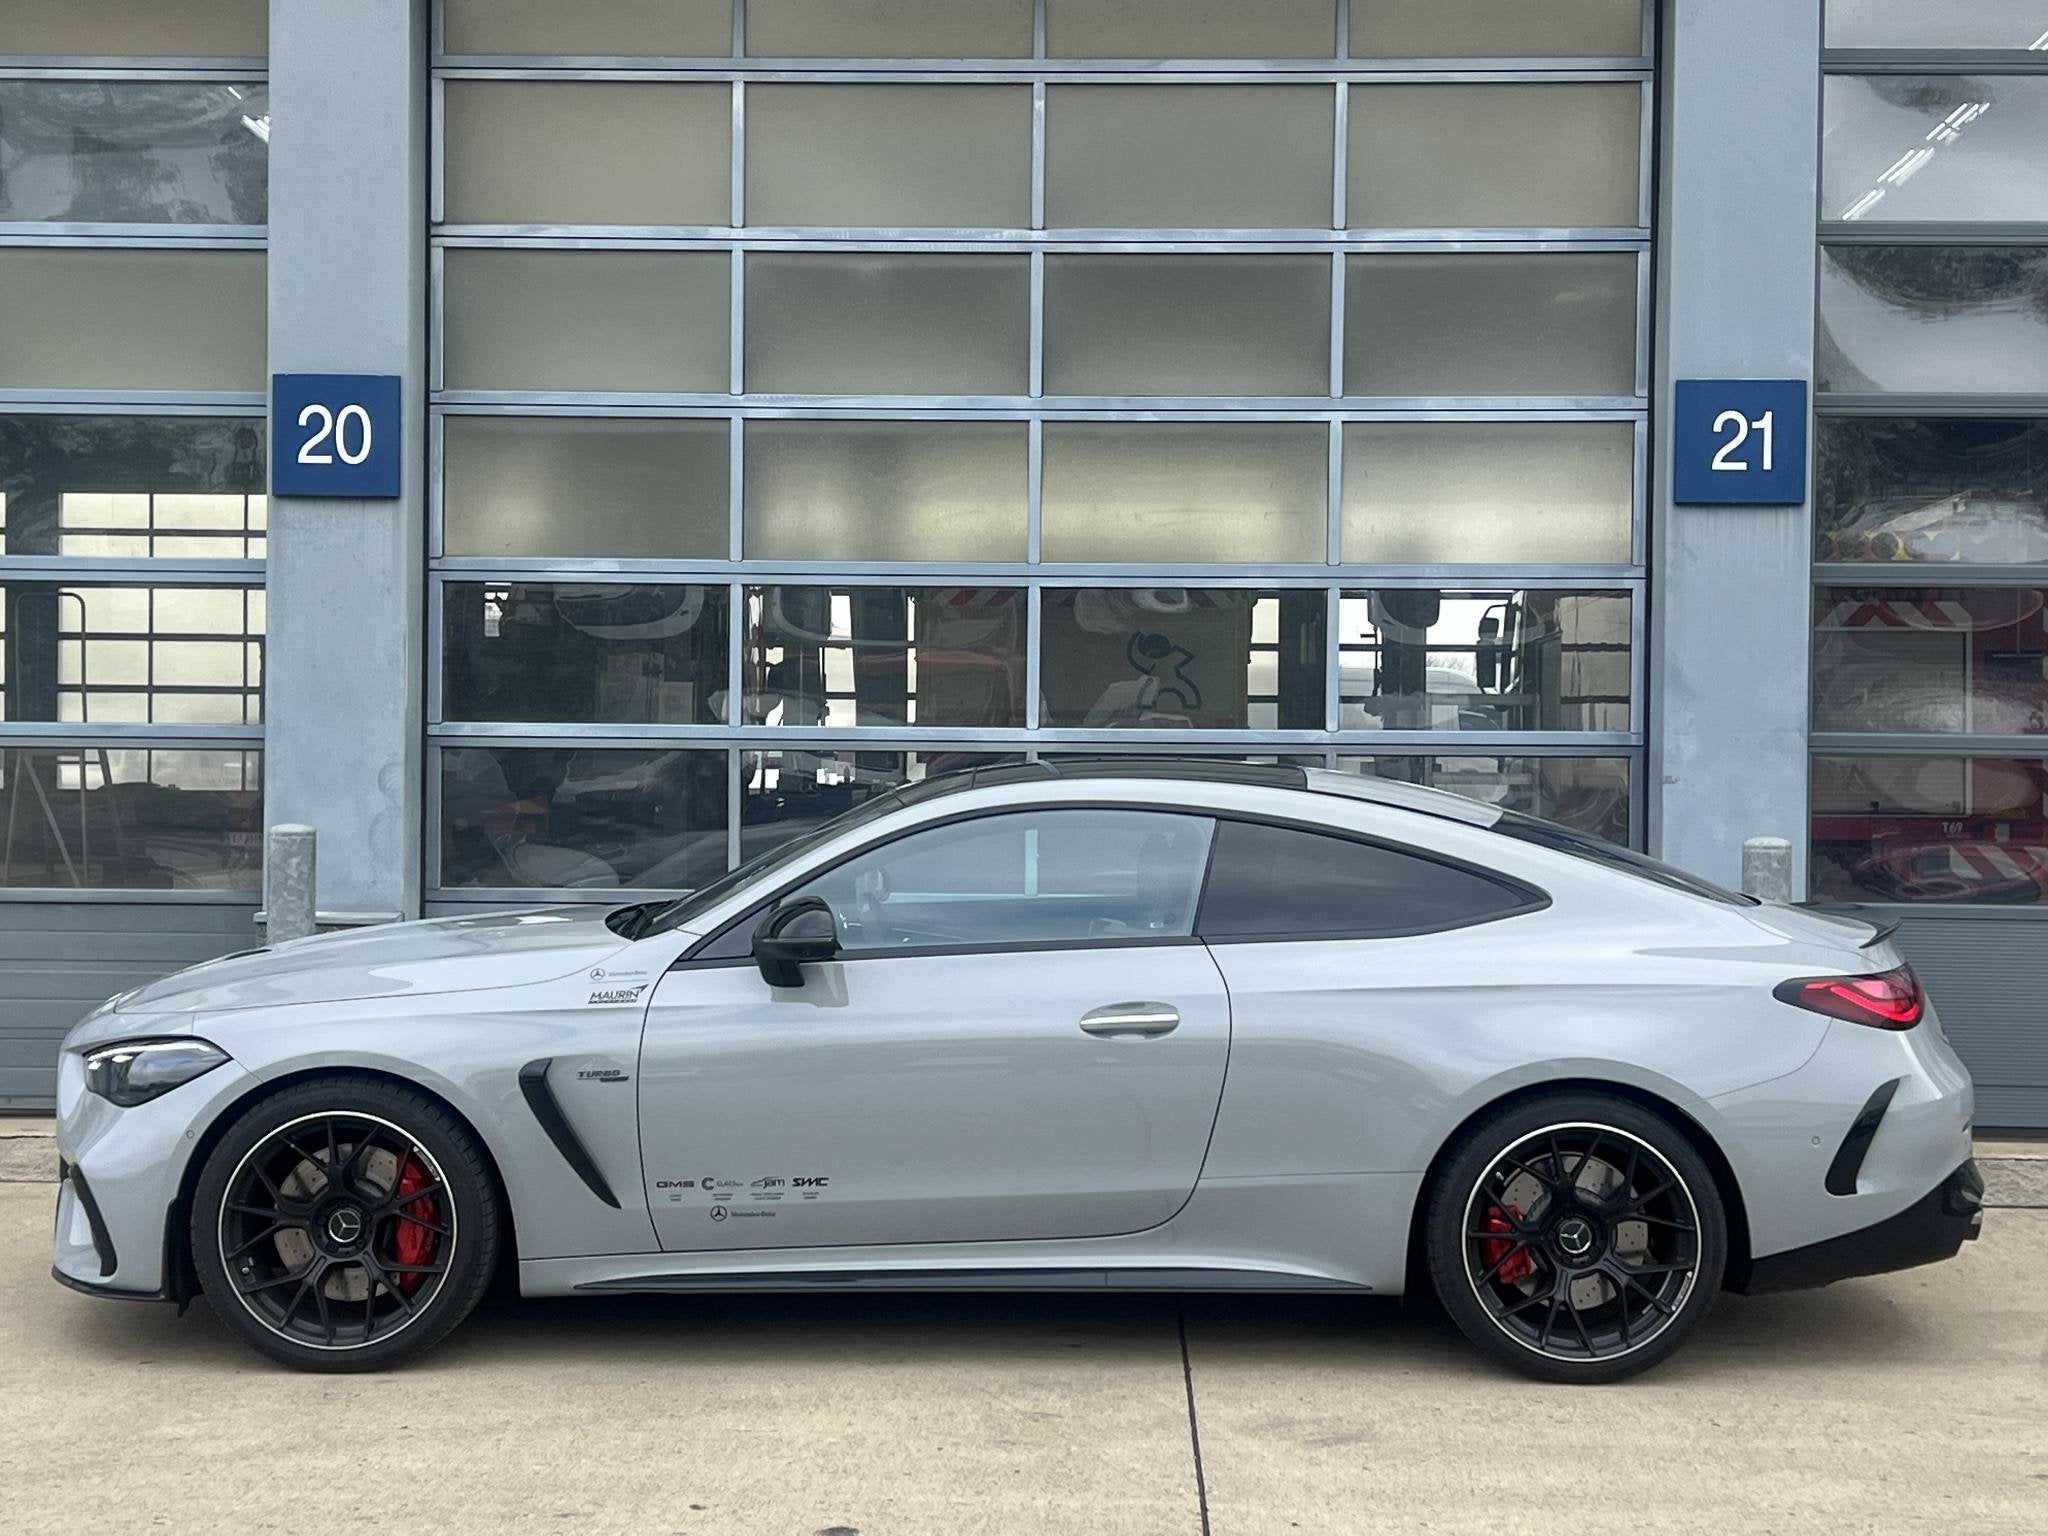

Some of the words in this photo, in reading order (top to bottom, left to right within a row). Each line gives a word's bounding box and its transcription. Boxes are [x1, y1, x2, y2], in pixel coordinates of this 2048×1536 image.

[297, 404, 372, 465] 20
[1711, 410, 1773, 471] 21
[589, 990, 640, 1000] MAURIN
[577, 1070, 621, 1078] TURBO
